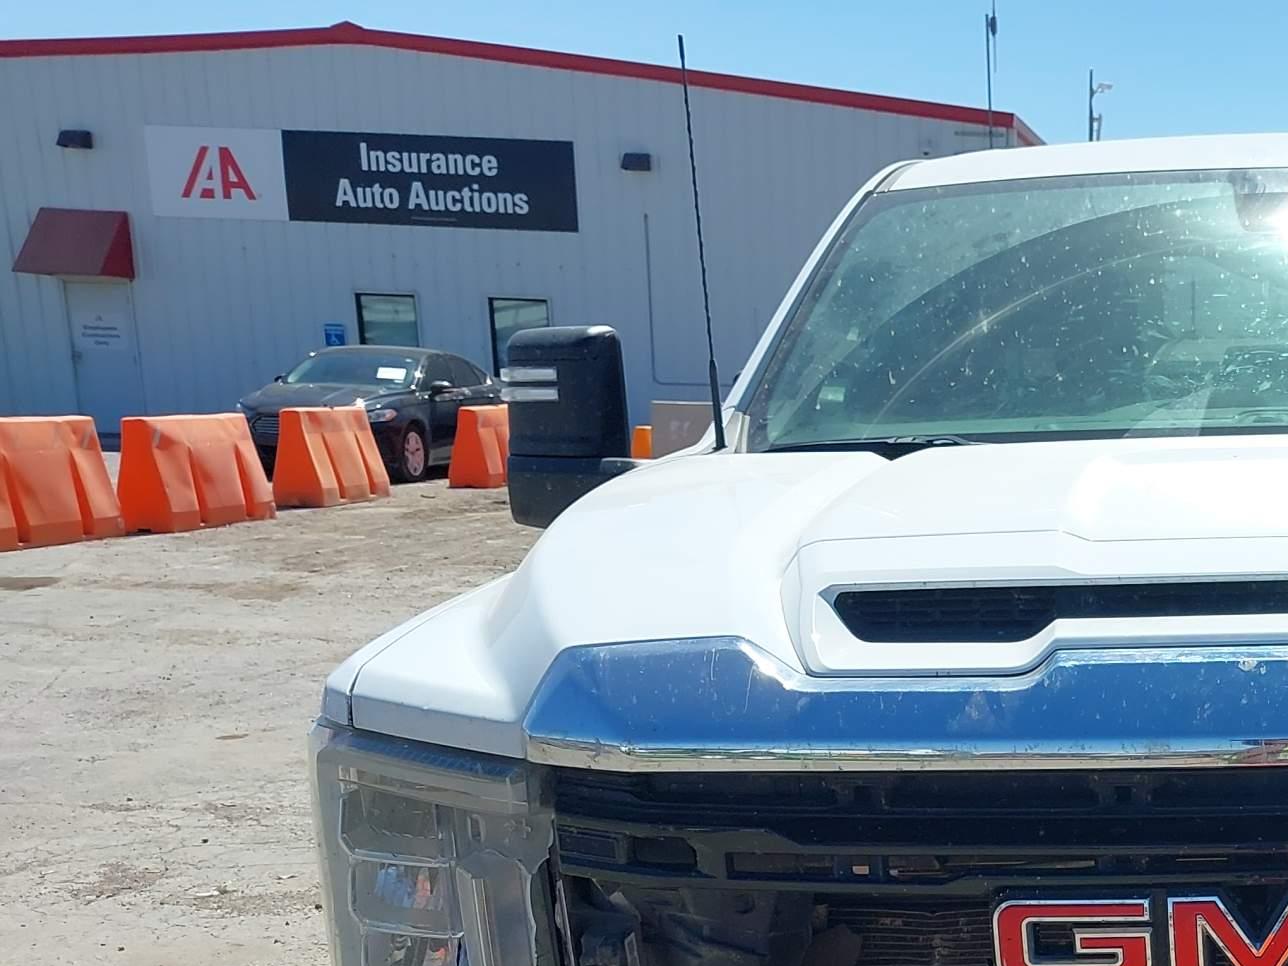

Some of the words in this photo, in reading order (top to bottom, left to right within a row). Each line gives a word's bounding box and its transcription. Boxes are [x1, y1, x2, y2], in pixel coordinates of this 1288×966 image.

[359, 142, 499, 177] Insurance
[335, 178, 400, 210] Auto
[407, 181, 530, 216] Auctions
